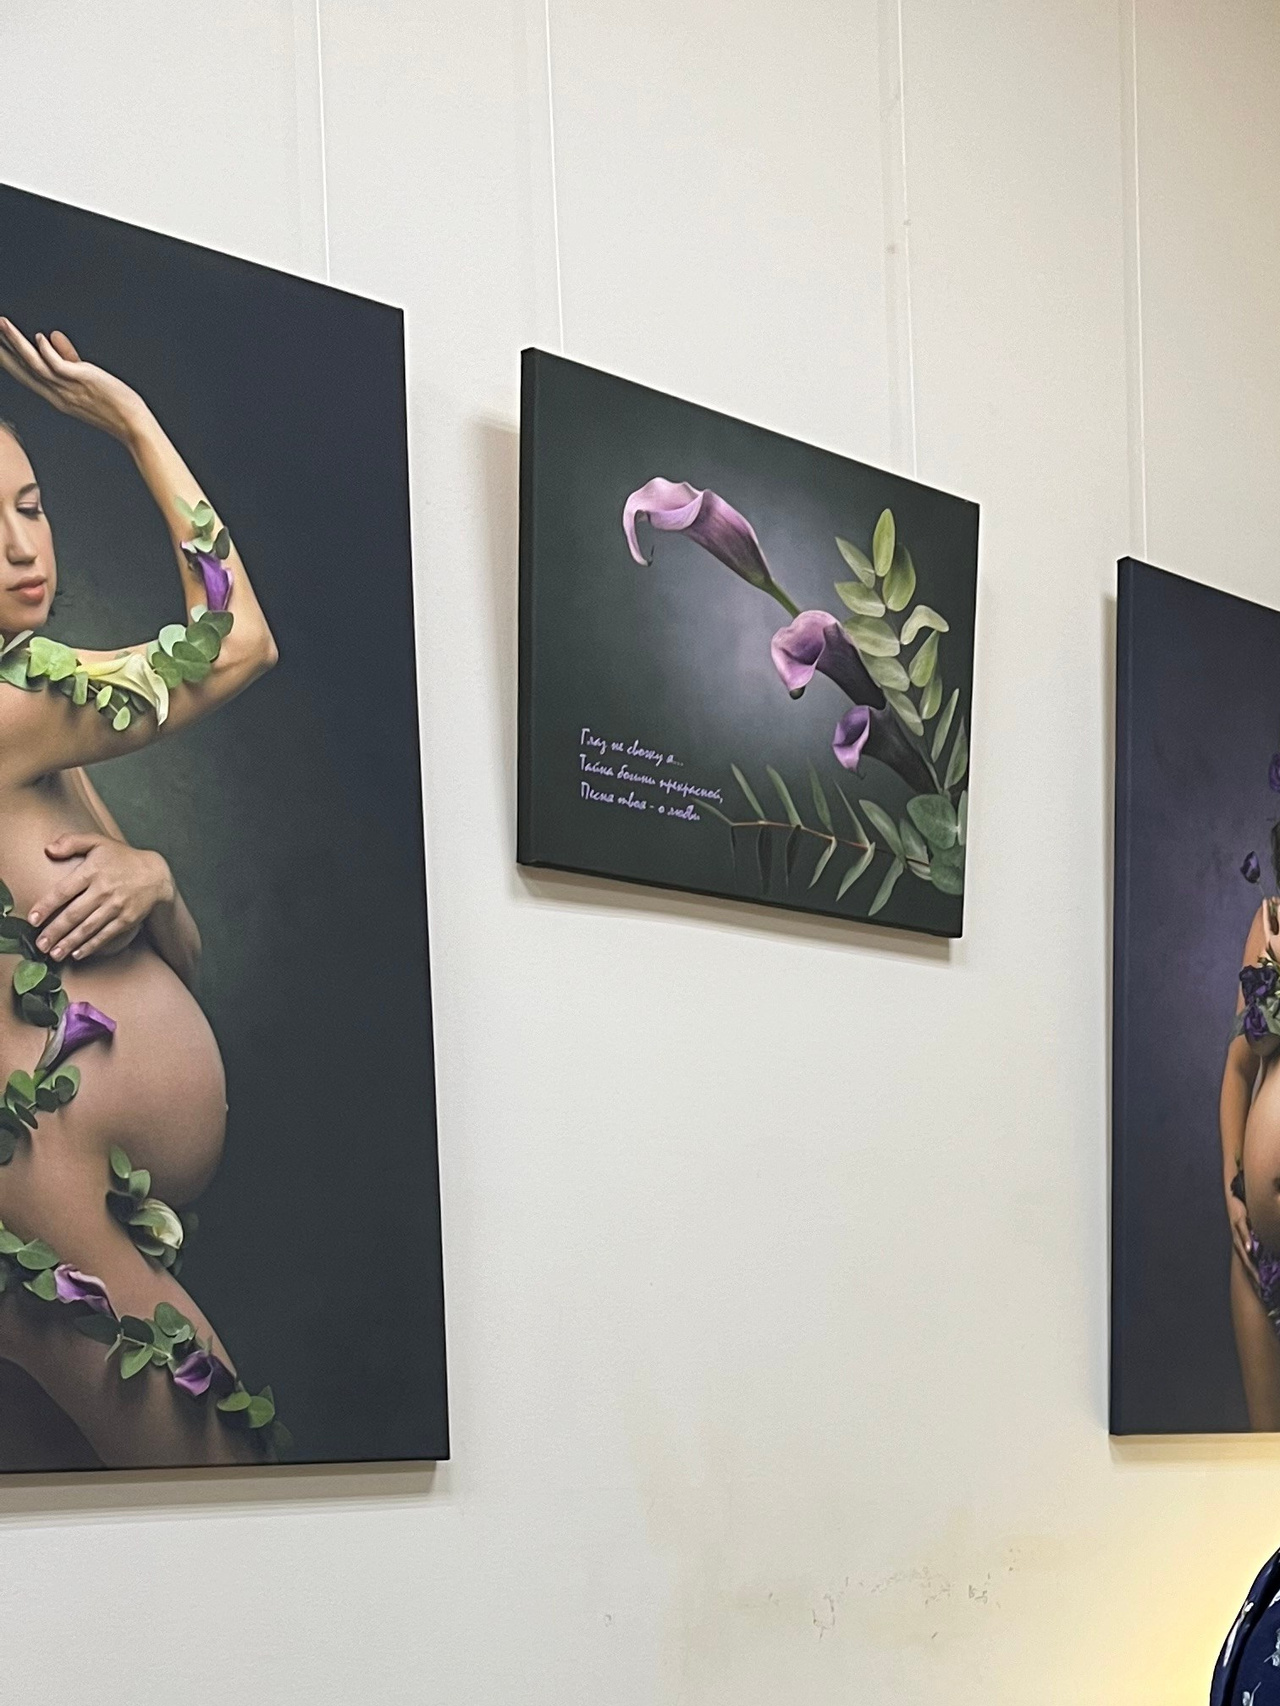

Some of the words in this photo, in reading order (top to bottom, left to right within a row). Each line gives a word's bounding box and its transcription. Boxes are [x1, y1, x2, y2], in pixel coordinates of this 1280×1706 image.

[580, 728, 607, 755] Глаз
[611, 742, 624, 752] не
[626, 739, 664, 767] свожу
[579, 754, 614, 777] Тайна
[616, 764, 656, 785] богини
[660, 779, 724, 804] прекрасной,
[581, 781, 614, 803] Песня
[617, 791, 647, 810] твоя
[658, 805, 666, 814] о
[667, 804, 701, 821] любви
